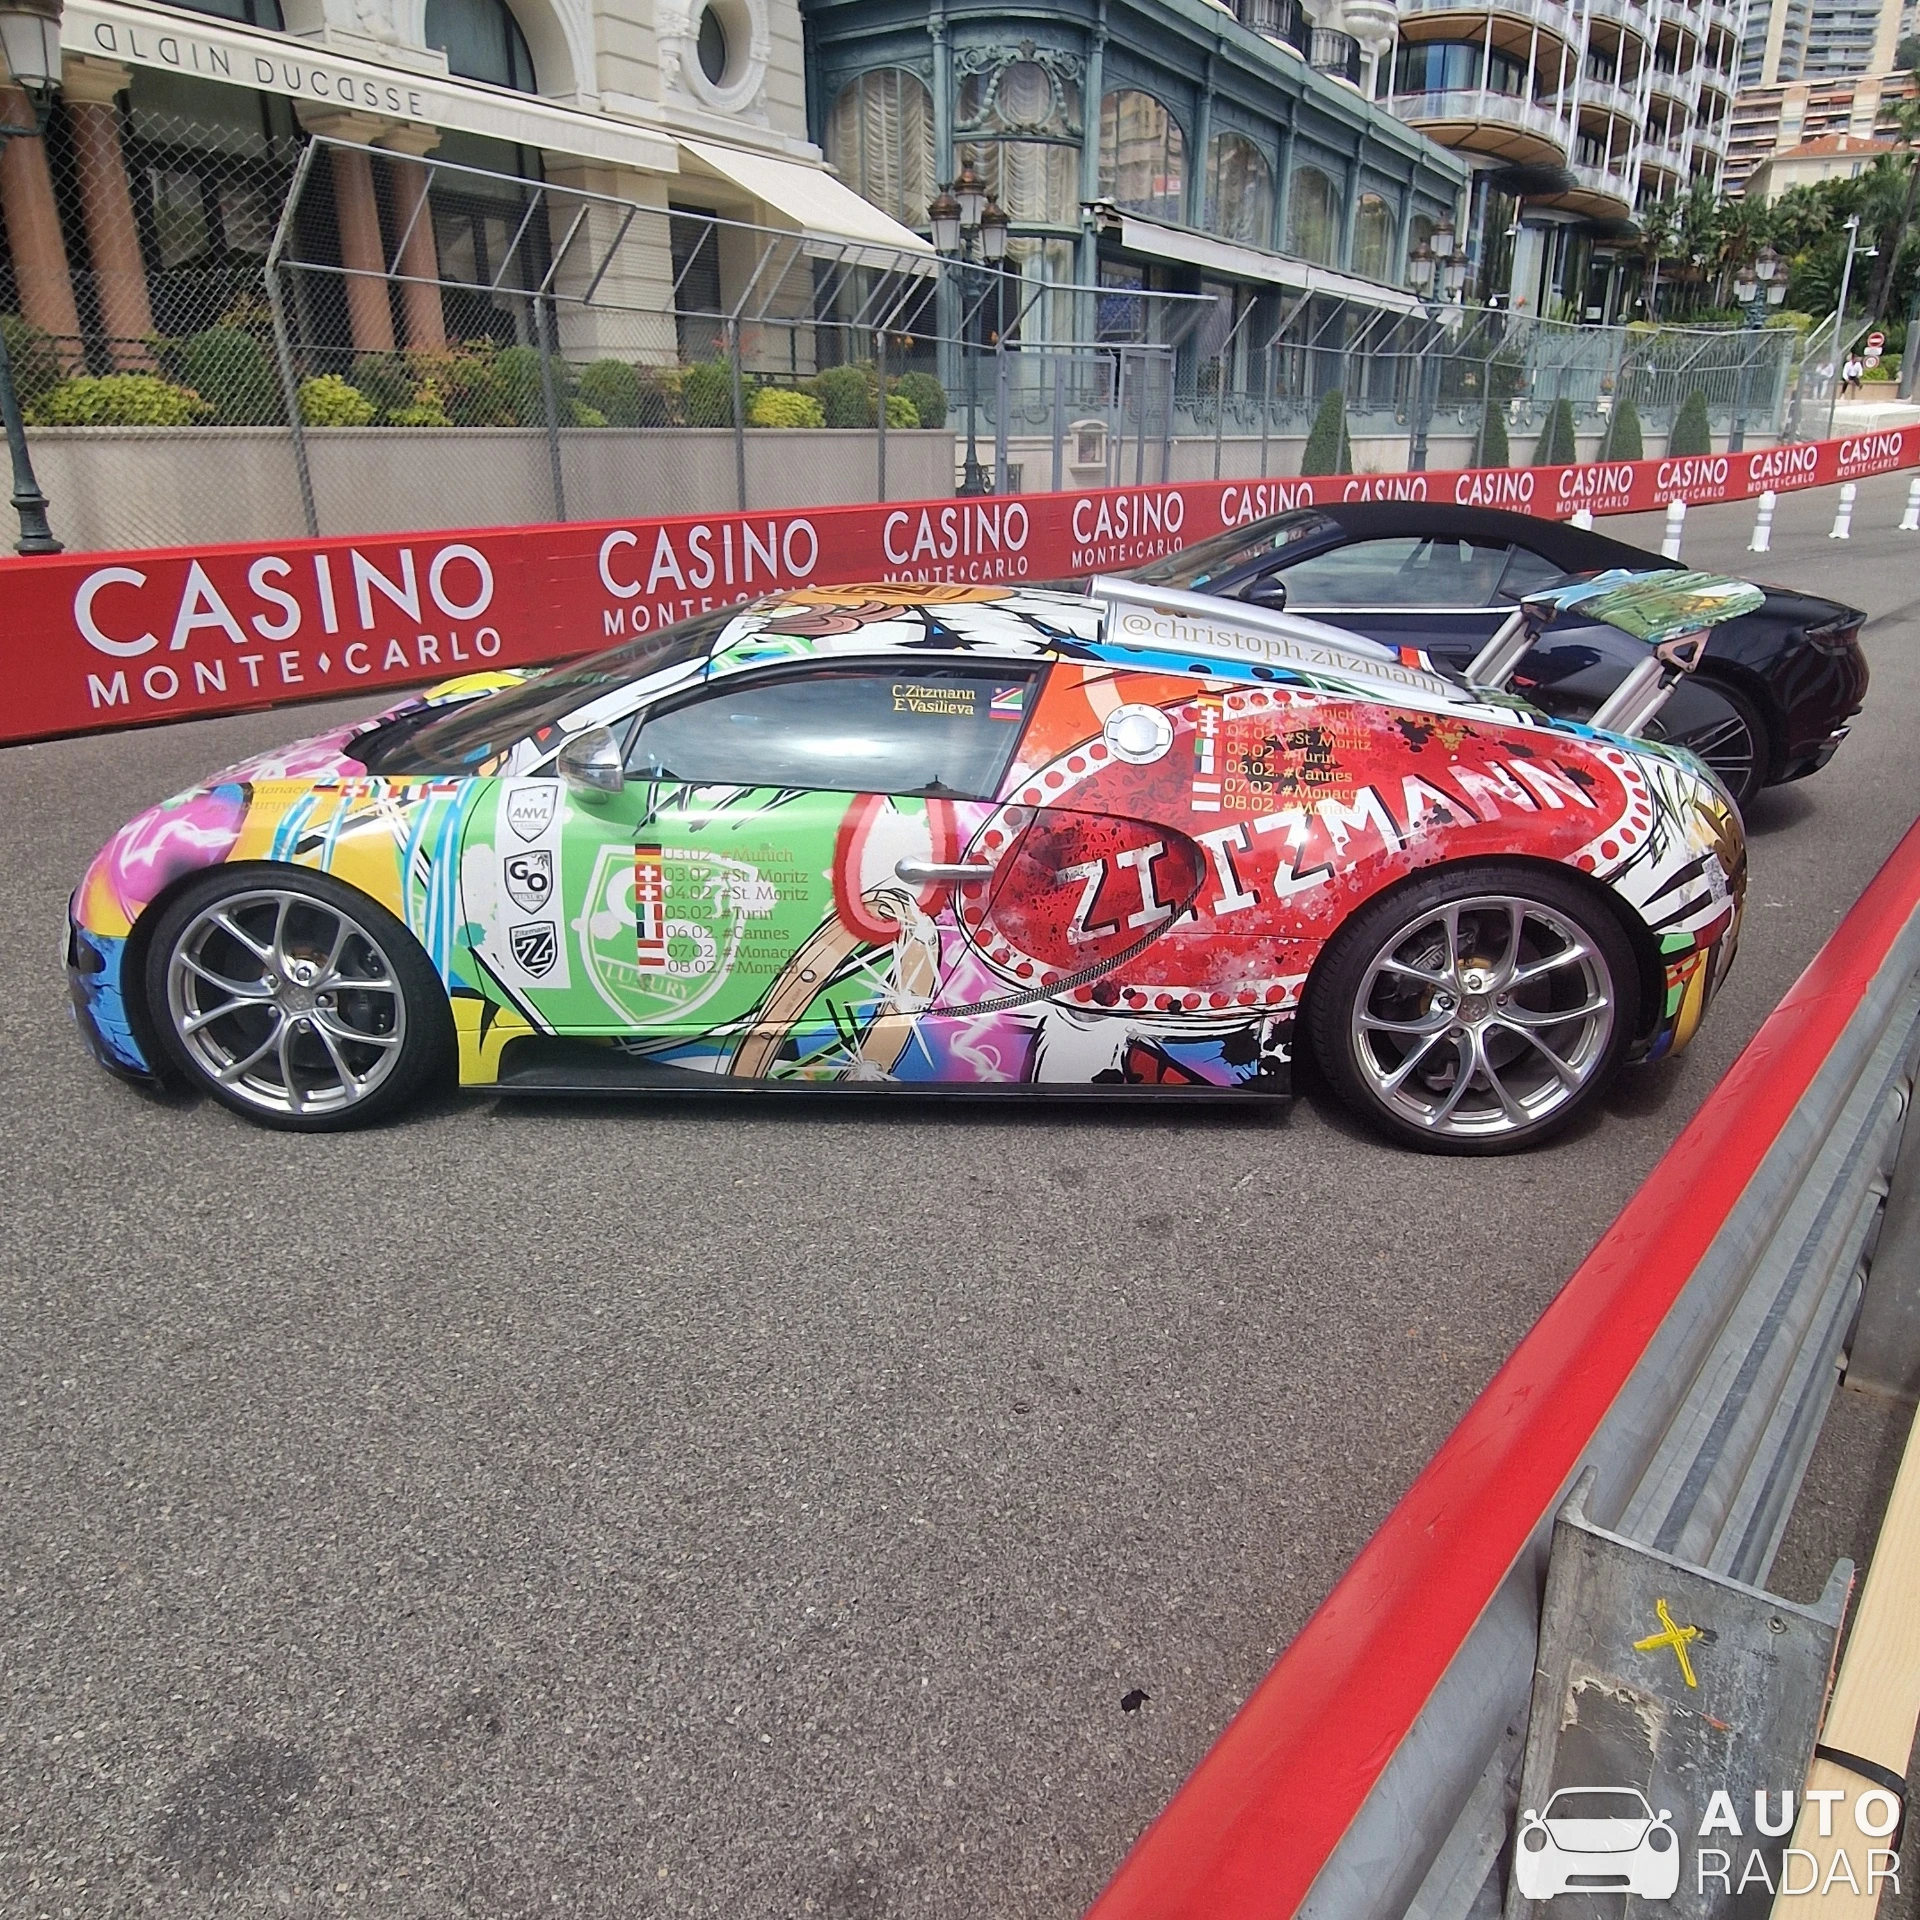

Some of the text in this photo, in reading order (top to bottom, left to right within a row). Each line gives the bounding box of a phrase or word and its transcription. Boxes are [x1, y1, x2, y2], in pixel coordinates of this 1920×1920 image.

[1839, 432, 1902, 464] CASINO
[1657, 458, 1728, 489] CASINO
[1749, 446, 1817, 479] CASINO
[1836, 457, 1899, 476] MONTE CARLO
[1455, 471, 1534, 506] CASINO
[1558, 465, 1634, 498] CASINO
[1747, 473, 1815, 493] MONTE CARLO
[1220, 482, 1314, 526] CASINO
[1597, 495, 1630, 510] CARLO
[1654, 486, 1725, 503] MONTE CARLO
[1072, 491, 1185, 544] CASINO
[883, 502, 1029, 565] CASINO
[599, 518, 819, 599] CASINO
[1072, 537, 1184, 568] MONTE CARLO
[969, 556, 1029, 581] CARLO
[74, 543, 496, 658] CASINO
[603, 597, 713, 637] MONTE
[1122, 614, 1446, 697] @christoph.zitzmann
[88, 627, 502, 709] MONTE CARLO
[1227, 742, 1336, 764] 05.02. #Turin
[1318, 734, 1372, 750] Moritz
[1226, 761, 1353, 782] 06.02. #Cannes
[1224, 778, 1360, 800] 07.02. #Monaco
[513, 807, 548, 819] ANVL
[1223, 795, 1361, 815] 08.02. #Monaco
[663, 848, 715, 861] 03.02.
[1051, 757, 1602, 945] ZITZMANN
[509, 861, 548, 892] GO
[664, 868, 808, 883] 03.02. #St. Moritz
[664, 885, 808, 900] 04.02. #St. Moritz
[665, 906, 773, 920] 05.02. #Turin
[666, 925, 789, 940] 06.02. #Cannes
[667, 944, 796, 958] 07.02. #Monaco
[668, 960, 799, 974] 08.02. #Monaco
